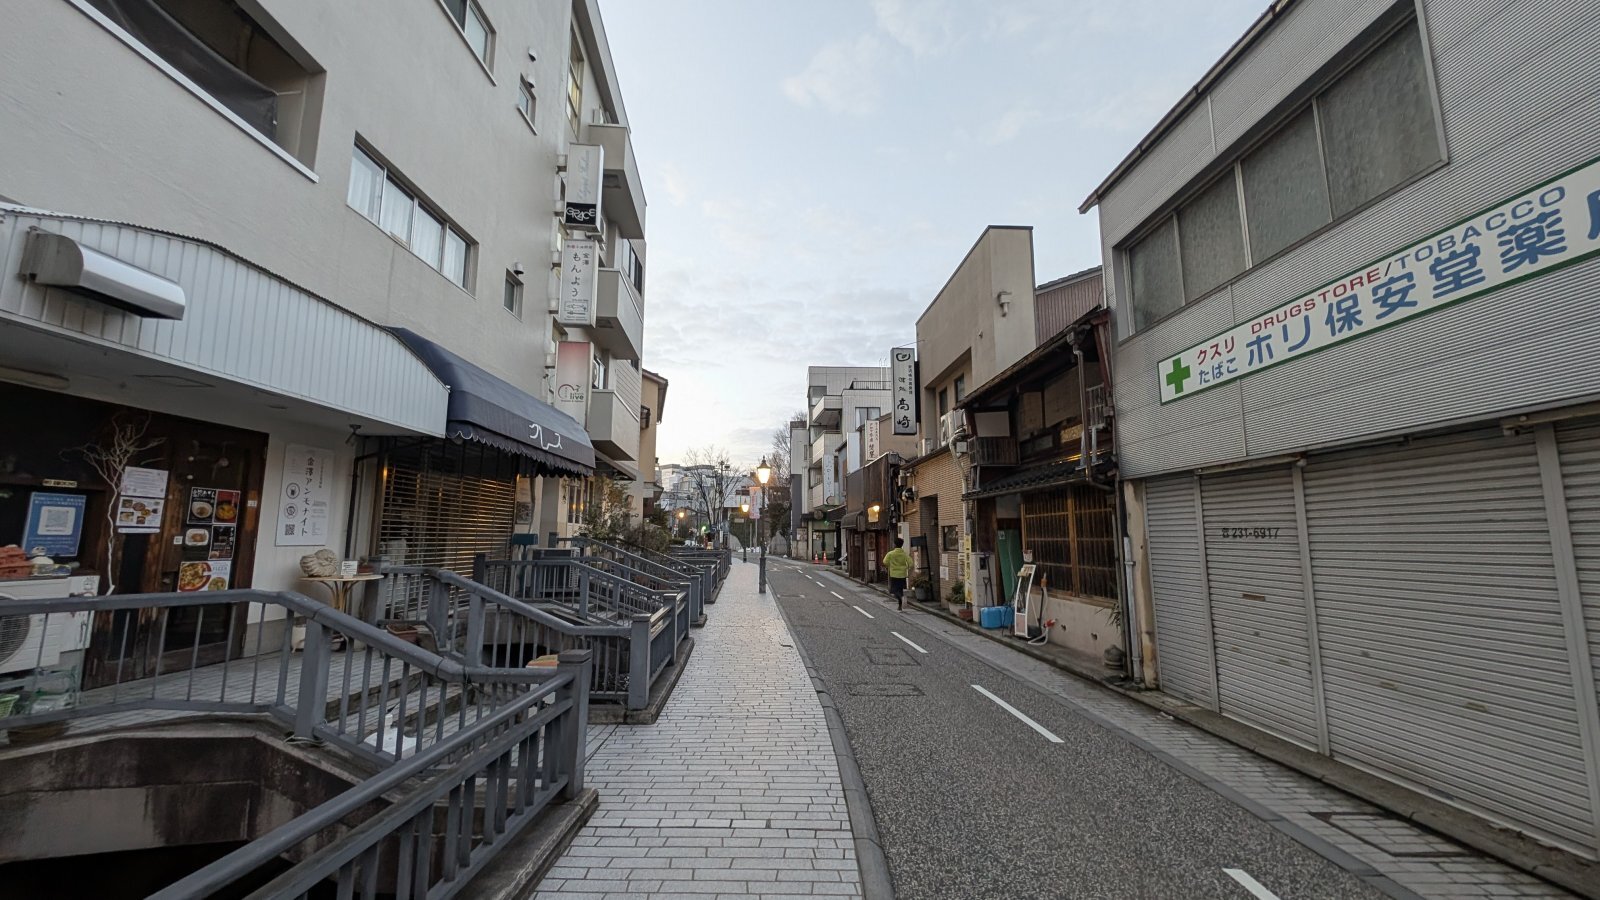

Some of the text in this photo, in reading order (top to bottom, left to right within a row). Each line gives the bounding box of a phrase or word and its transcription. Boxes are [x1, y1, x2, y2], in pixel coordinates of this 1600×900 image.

[566, 207, 596, 221] GRACE
[571, 252, 582, 297] もんよう
[1251, 186, 1566, 334] DRUGSTORE/TOBACCO
[1197, 335, 1235, 365] クスリ
[1198, 357, 1238, 385] たばこ
[1232, 527, 1280, 539] 231-6917
